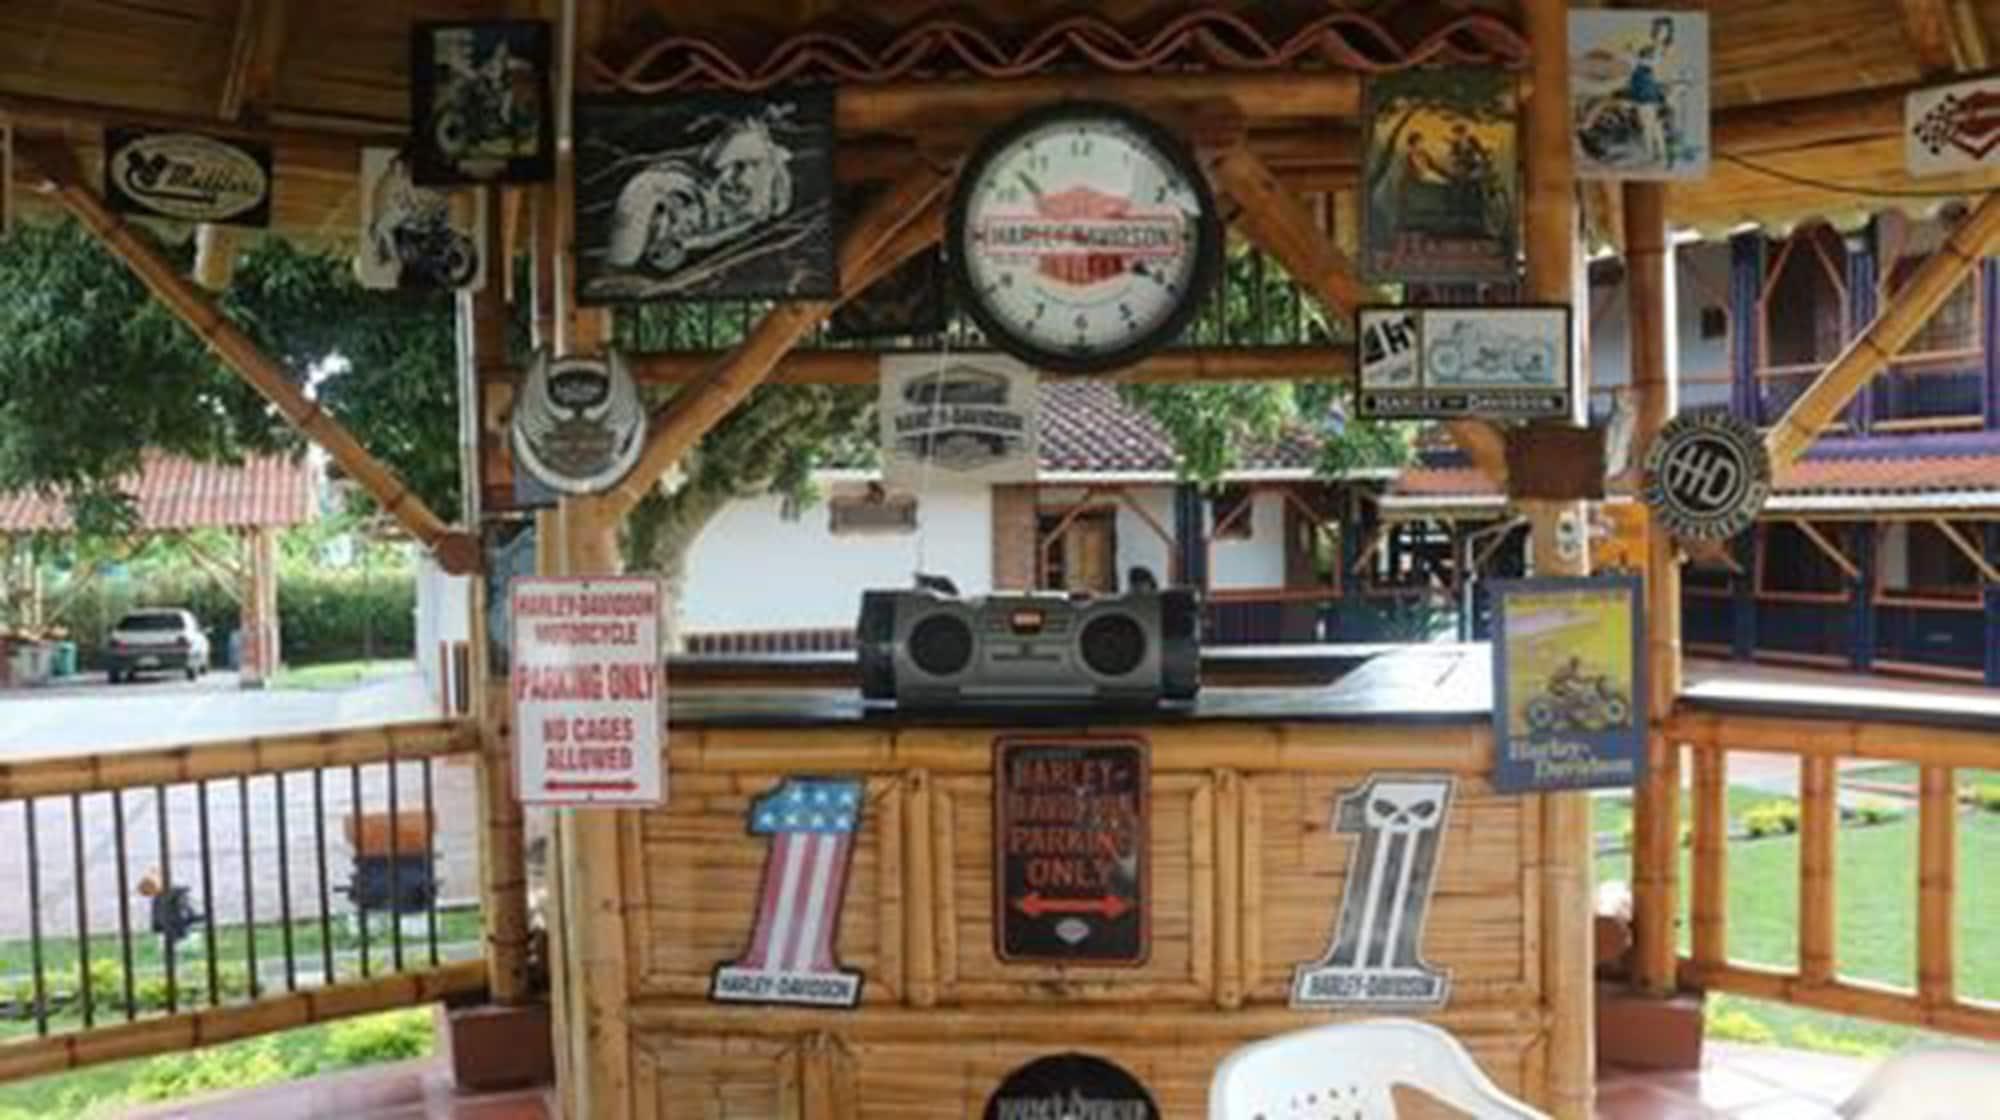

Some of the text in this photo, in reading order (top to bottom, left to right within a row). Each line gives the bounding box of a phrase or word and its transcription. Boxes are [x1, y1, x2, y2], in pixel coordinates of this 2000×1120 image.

[513, 592, 656, 616] HARLEY-DAVIDSON
[534, 622, 639, 645] MOTORCYCLE
[513, 663, 656, 700] PARKING ONLY
[543, 717, 633, 742] NO CAGES
[545, 746, 633, 770] ALLOWED
[1025, 858, 1117, 887] ONLY
[719, 974, 852, 998] HARLEY-DAVIDSON
